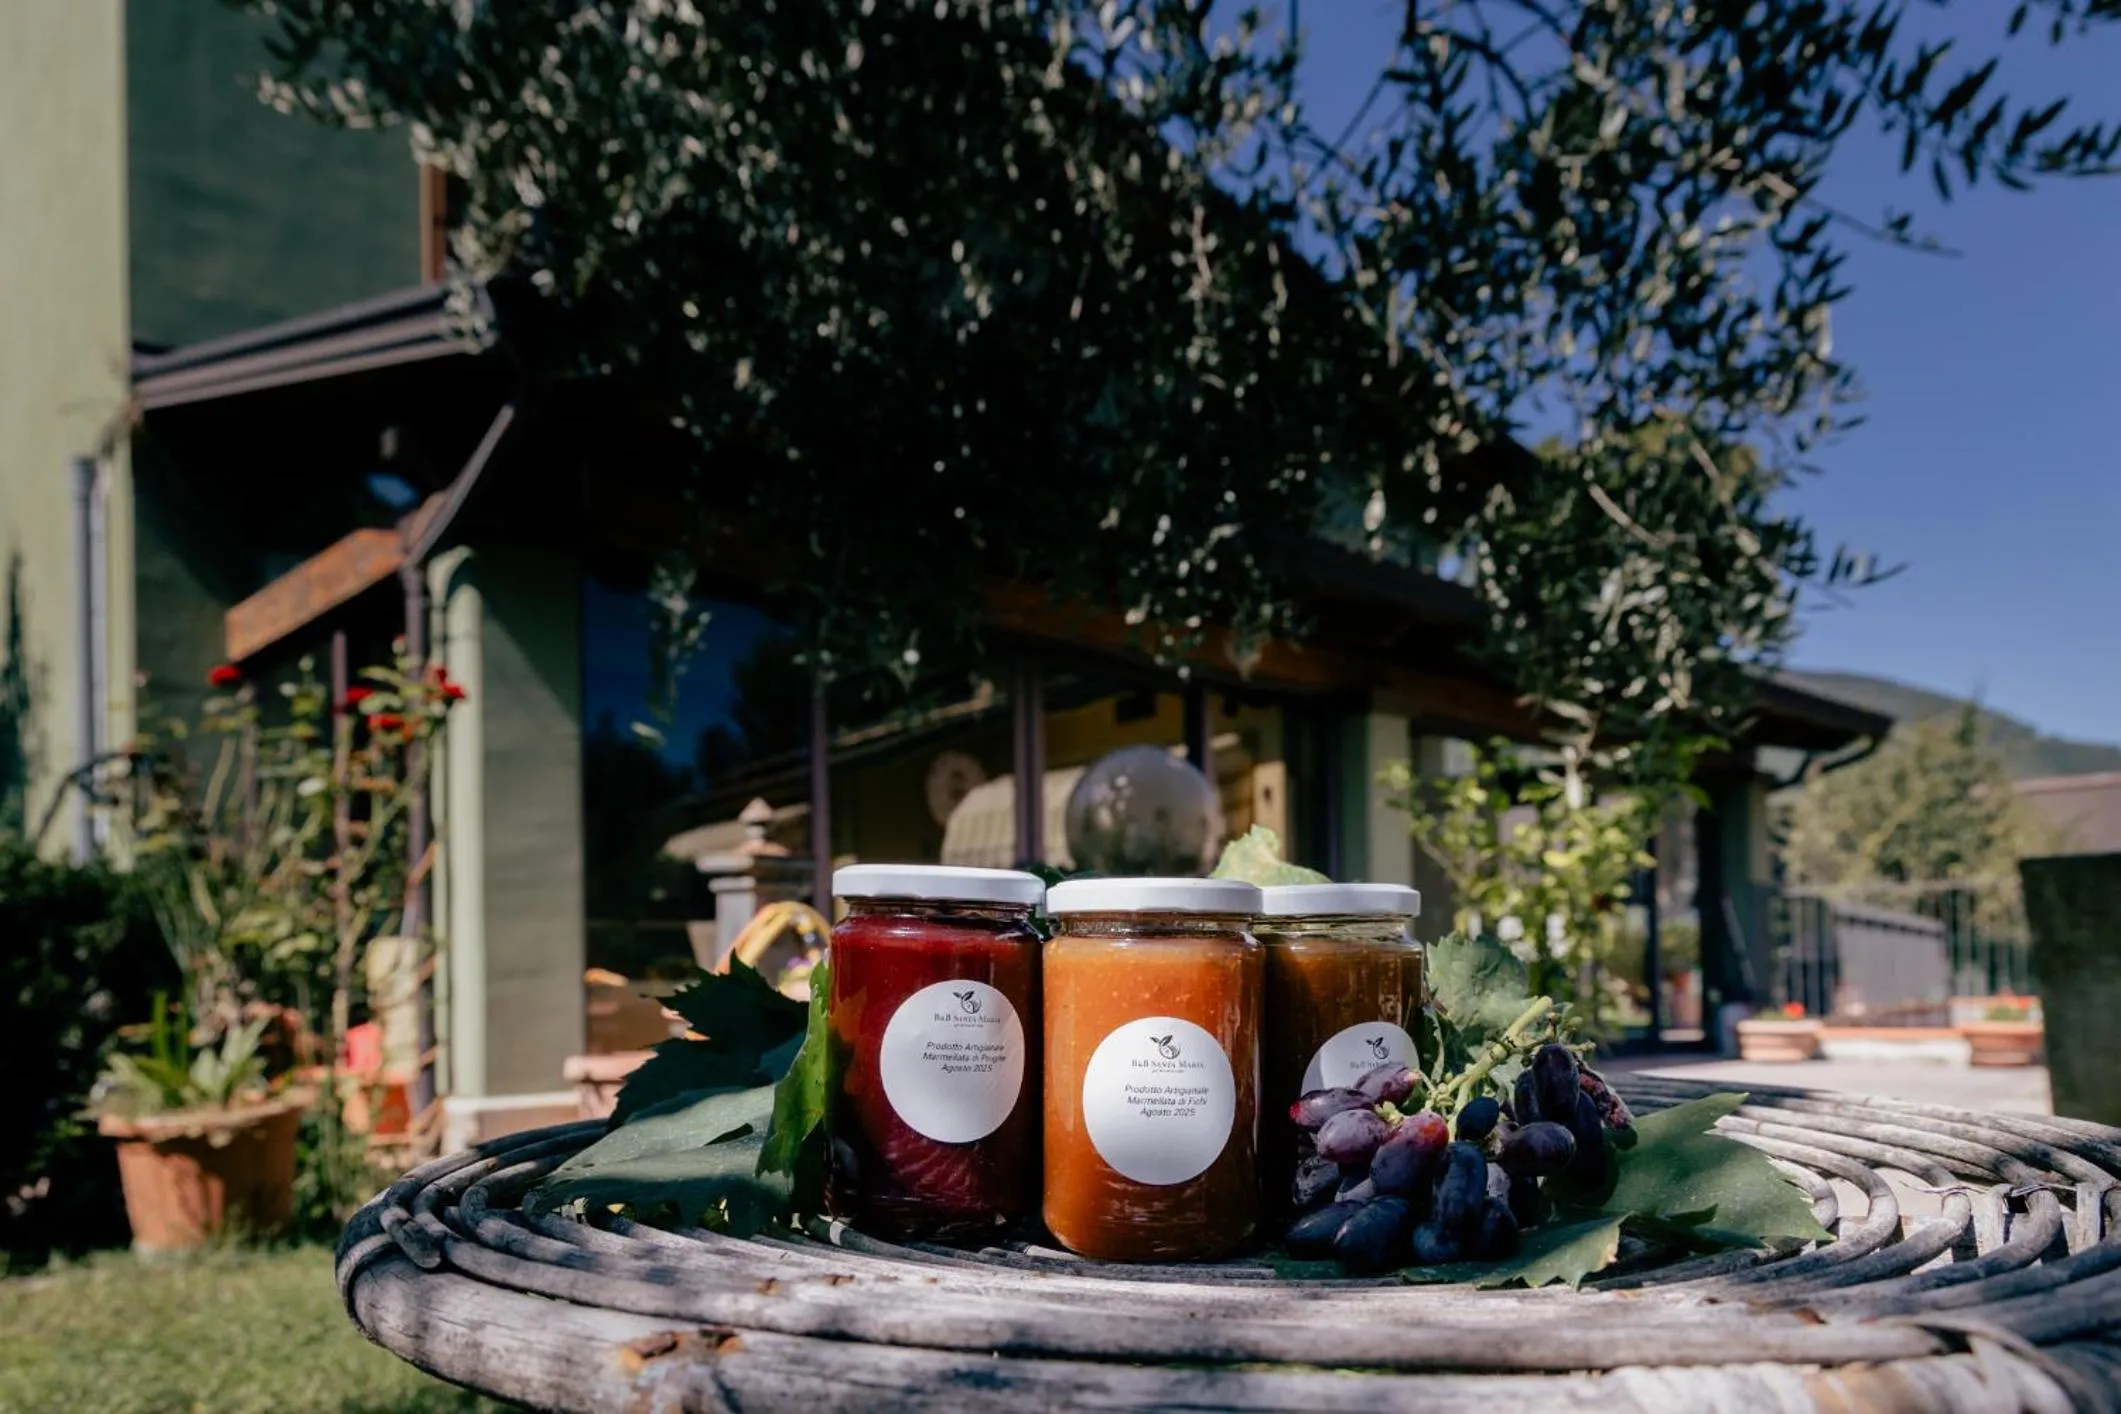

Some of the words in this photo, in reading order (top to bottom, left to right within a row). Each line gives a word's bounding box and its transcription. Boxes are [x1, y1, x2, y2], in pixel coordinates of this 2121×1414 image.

[926, 1041, 963, 1050] Prodotto
[964, 1043, 1005, 1052] Artigianale
[922, 1052, 970, 1062] Marmellata
[941, 1063, 972, 1074] Agosto
[973, 1064, 993, 1073] 2025
[1124, 1084, 1163, 1094] Prodotto
[1163, 1086, 1210, 1096] Artigianale
[1126, 1096, 1176, 1105] Marmellata
[1140, 1107, 1172, 1118] Agosto
[1173, 1108, 1197, 1117] 2025
